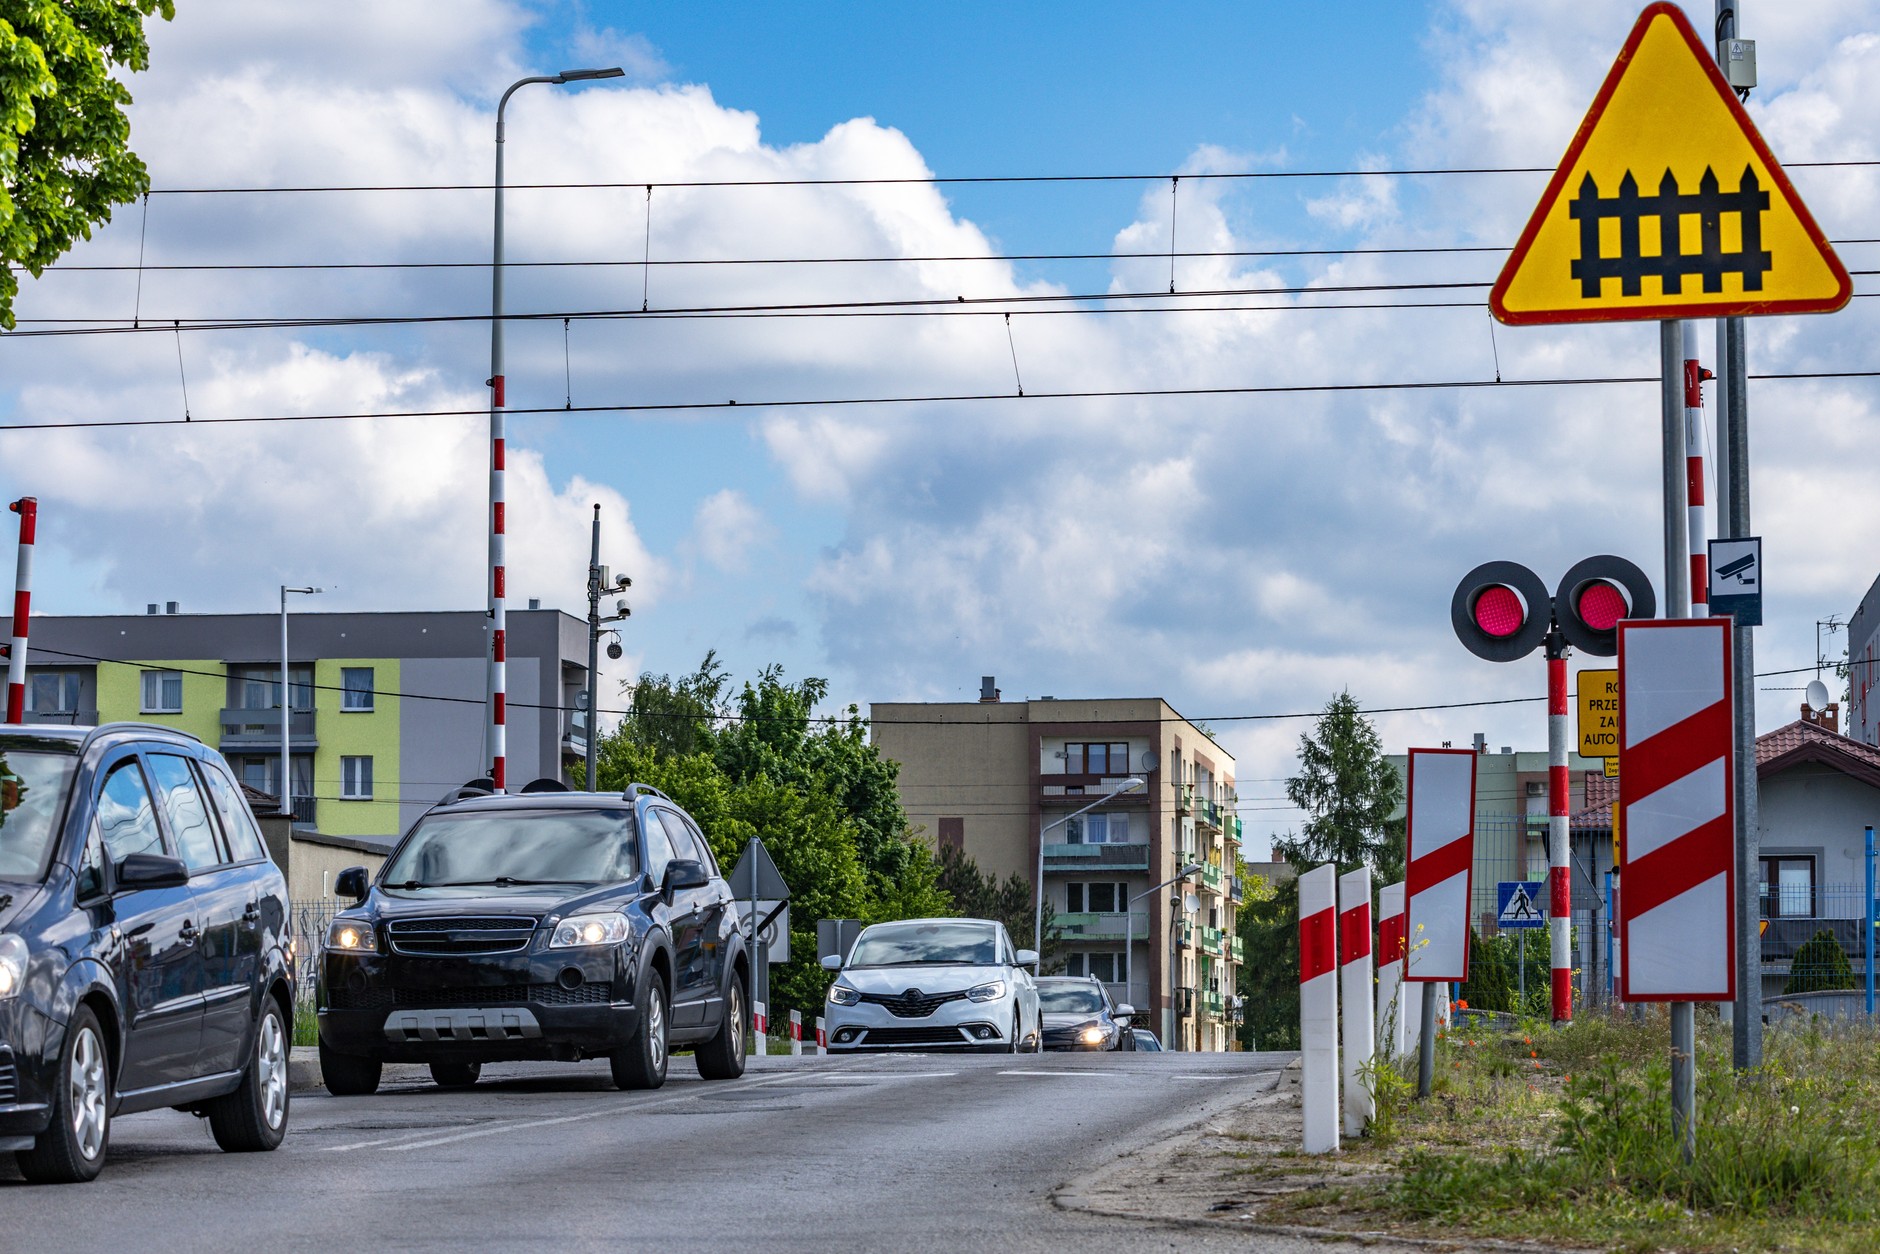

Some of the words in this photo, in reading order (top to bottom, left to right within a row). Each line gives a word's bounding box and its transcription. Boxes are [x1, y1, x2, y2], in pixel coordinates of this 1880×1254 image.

[1589, 699, 1618, 710] PRZE
[1600, 716, 1618, 727] ZA
[1584, 733, 1618, 745] AUTO
